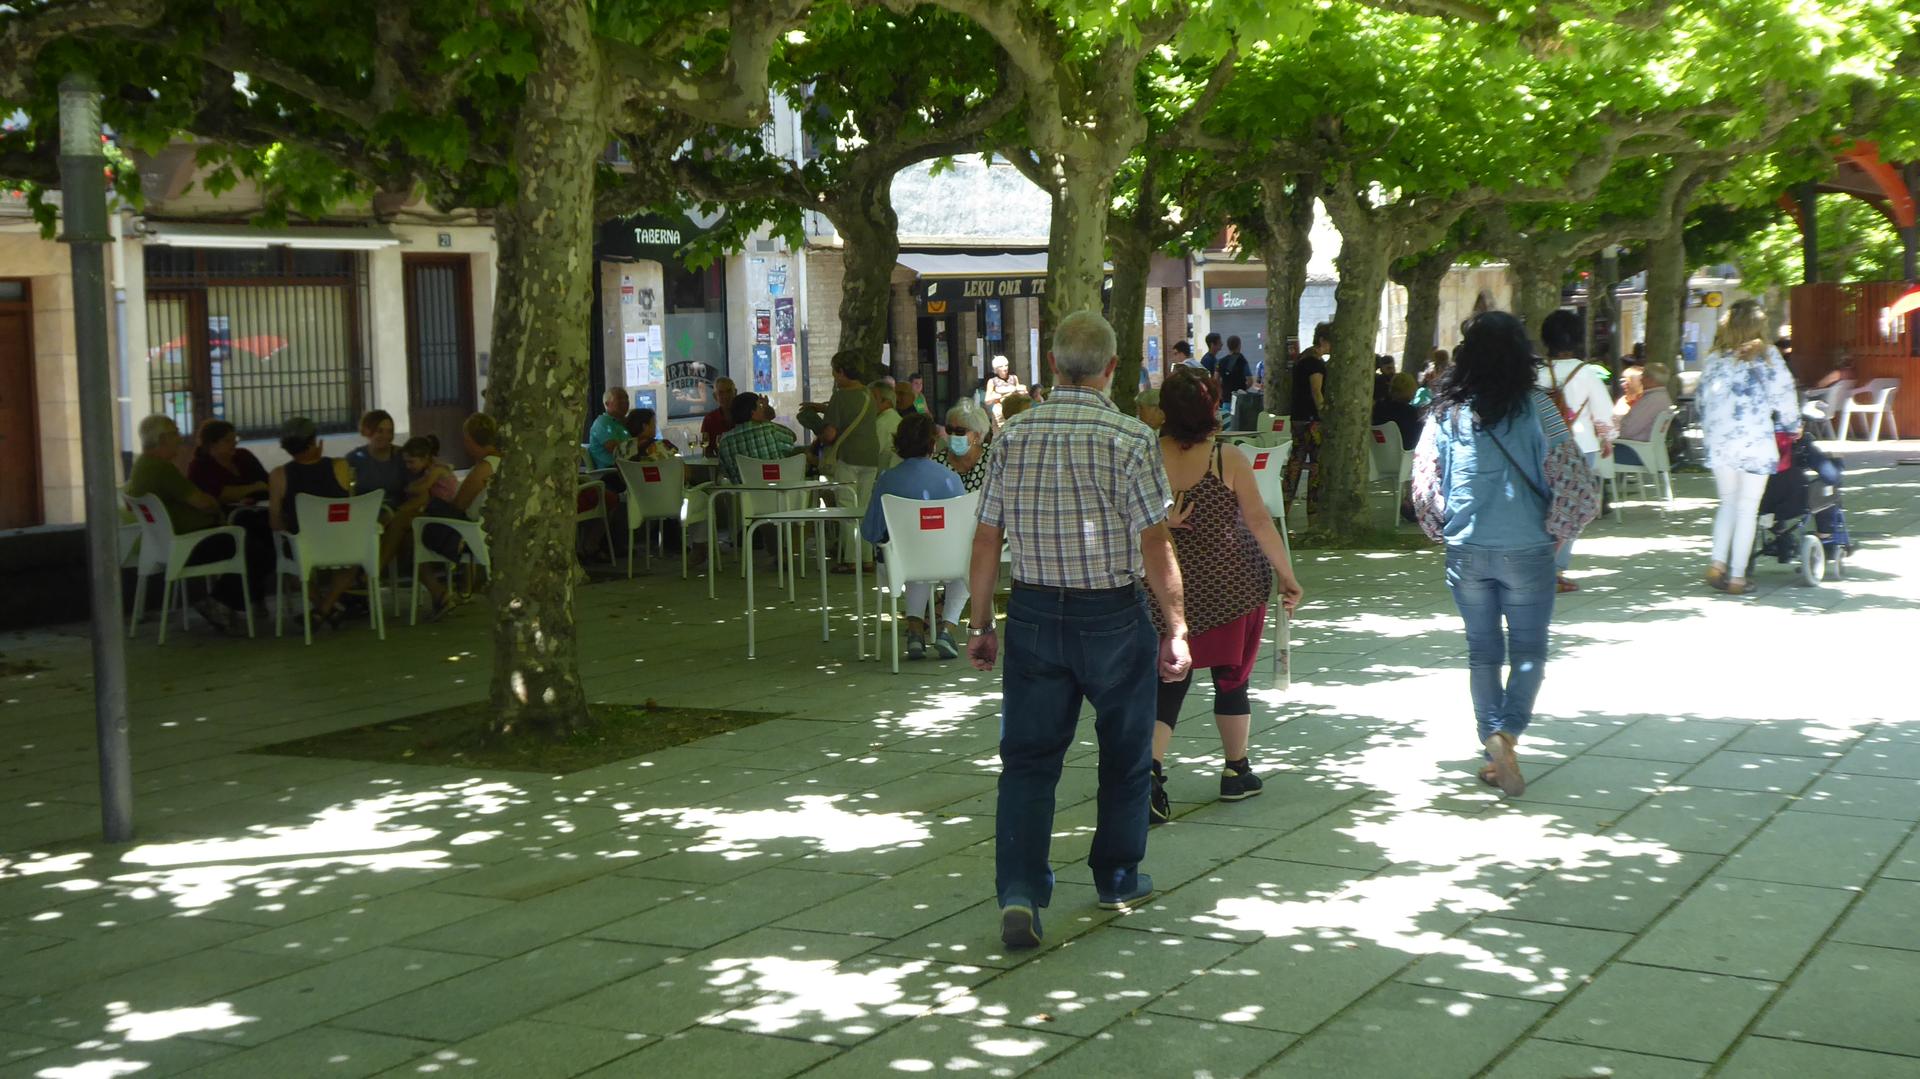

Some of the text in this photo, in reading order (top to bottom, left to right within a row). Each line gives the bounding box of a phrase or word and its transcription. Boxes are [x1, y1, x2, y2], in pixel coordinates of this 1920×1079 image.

[634, 228, 681, 245] TABERNA
[963, 278, 1047, 297] LEKU ONA TA
